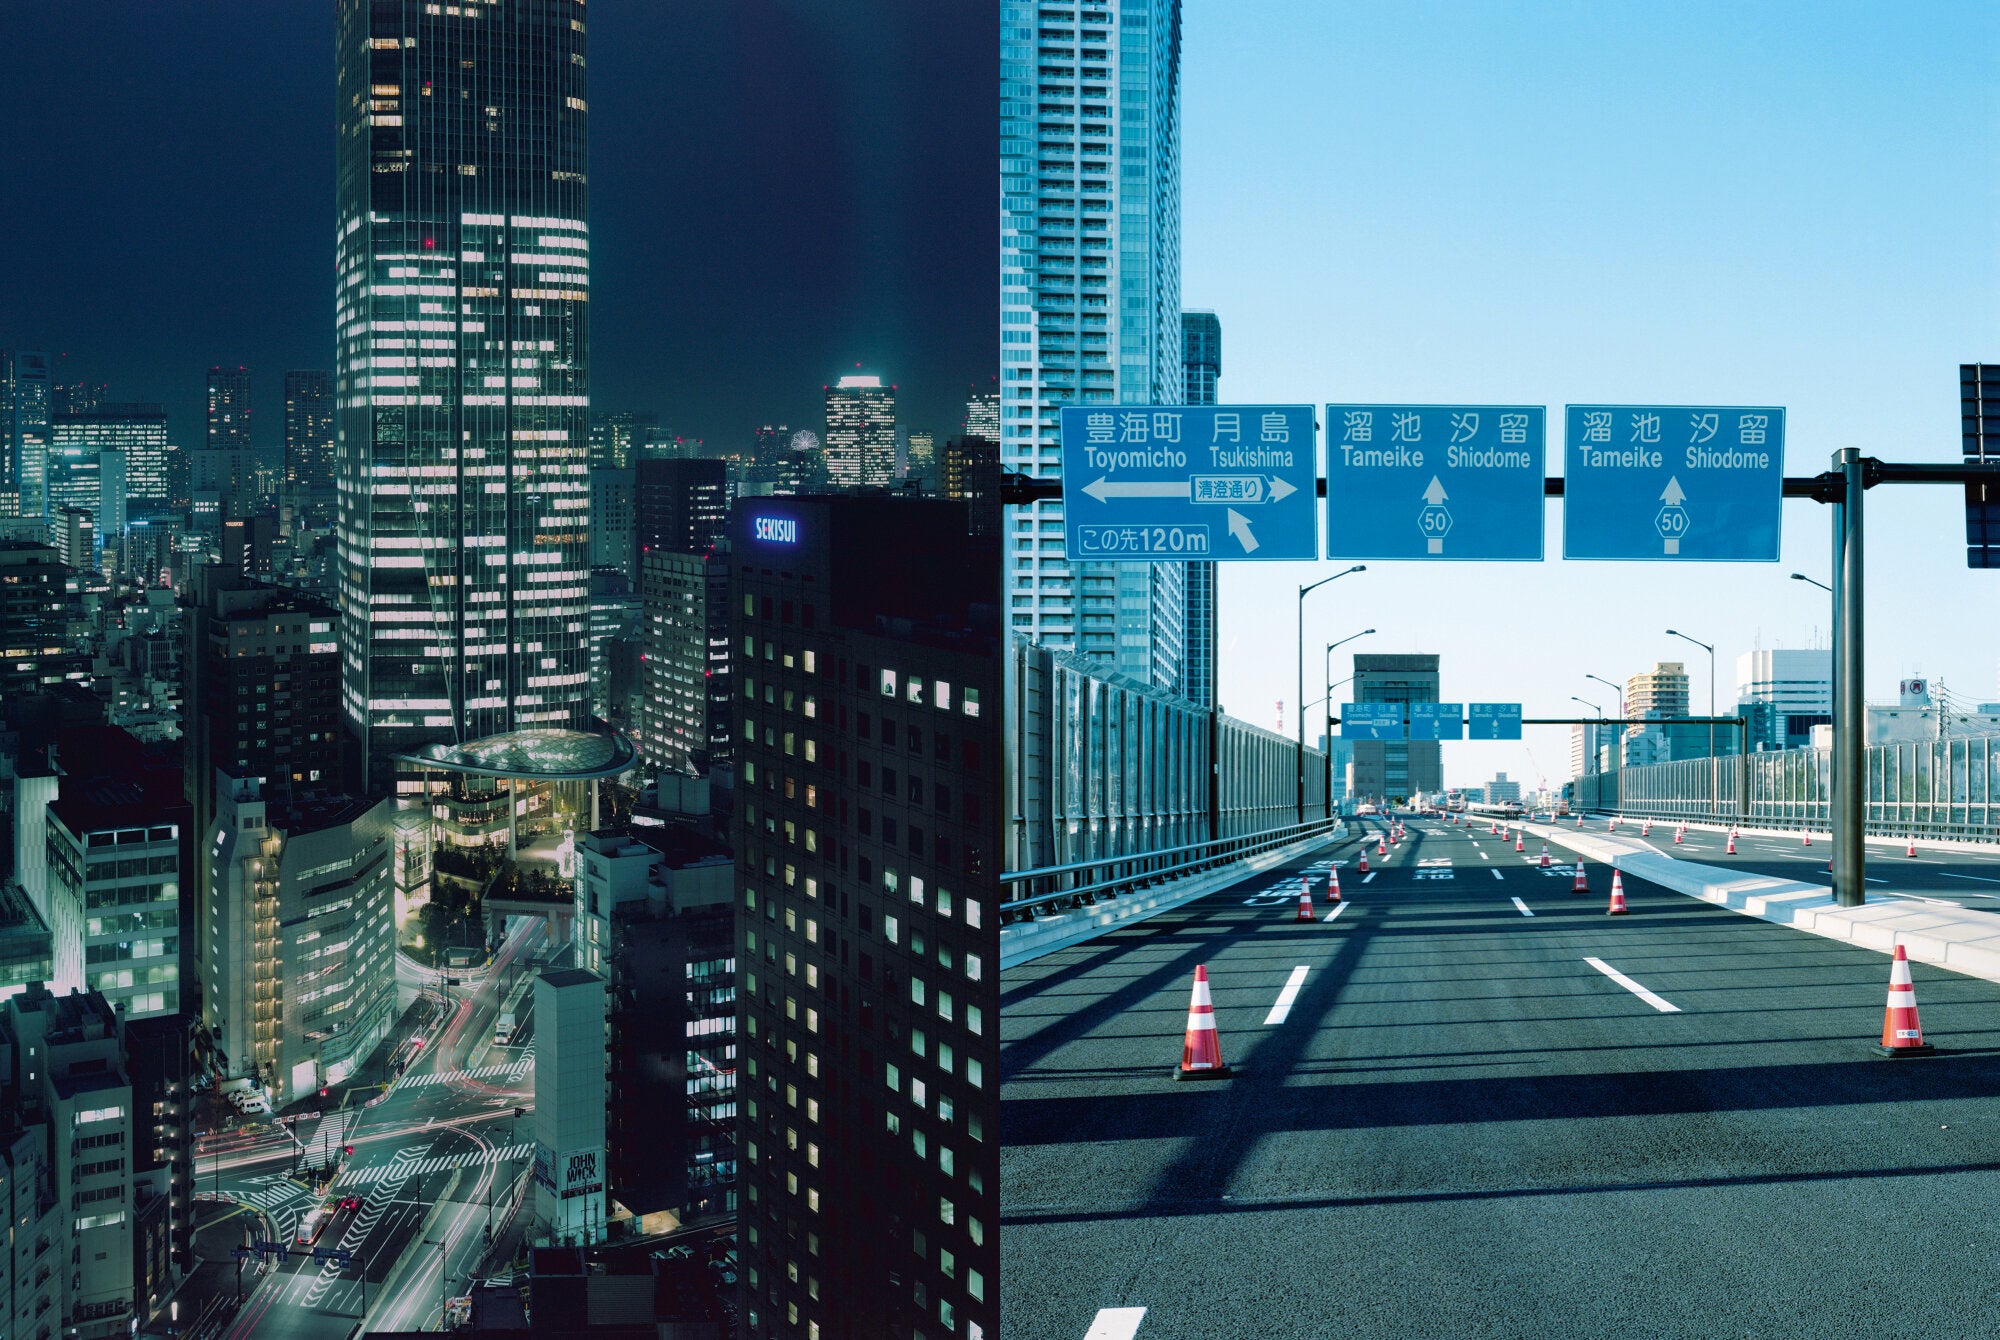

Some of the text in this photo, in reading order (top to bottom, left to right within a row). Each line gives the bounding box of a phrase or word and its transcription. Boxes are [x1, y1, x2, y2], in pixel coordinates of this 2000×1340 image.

[1085, 411, 1290, 444] 豊海町 月島
[1343, 411, 1528, 443] 溜池 汐留
[1582, 412, 1768, 445] 溜池 汐留
[1084, 446, 1294, 473] Toyomicho Tsukishima
[1340, 445, 1531, 469] Tameike Shiodome
[1579, 446, 1769, 469] Tameike Shiodome
[1198, 480, 1257, 500] 清澄通り
[755, 517, 797, 543] SEKISUI
[1424, 512, 1446, 531] 50
[1661, 513, 1683, 531] 50
[568, 1152, 596, 1171] JOHN
[567, 1165, 597, 1183] WICK
